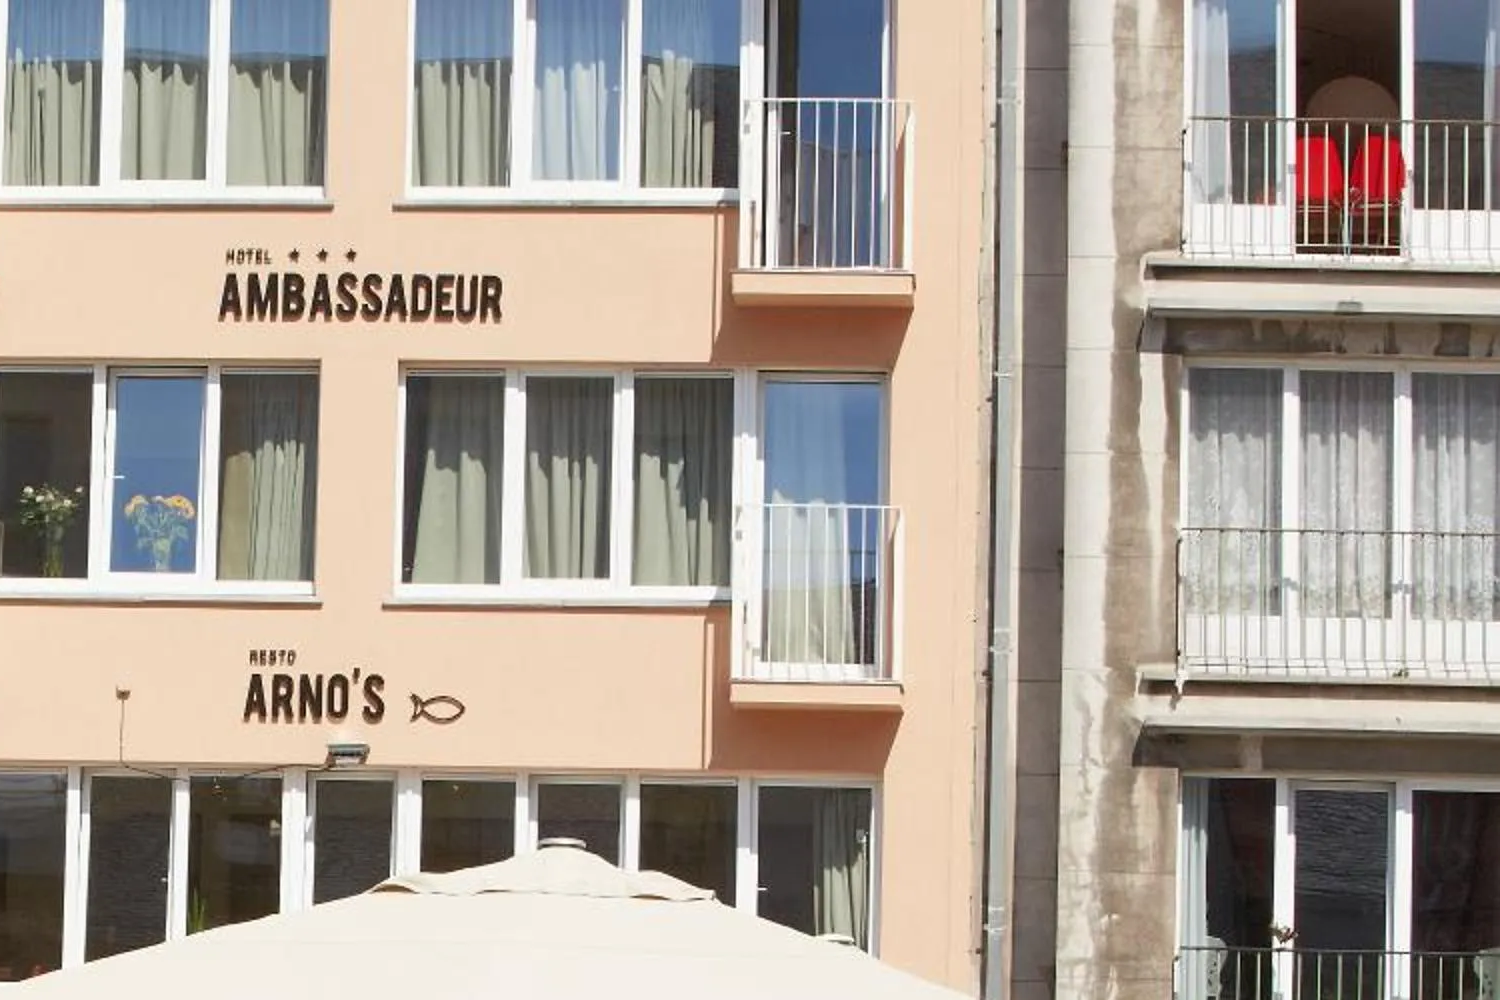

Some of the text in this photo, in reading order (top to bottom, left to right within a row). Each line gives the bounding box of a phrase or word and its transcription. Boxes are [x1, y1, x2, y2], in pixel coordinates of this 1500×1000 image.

[226, 248, 272, 265] HOTEL
[218, 272, 503, 323] AMBASSADEUR
[249, 649, 297, 666] RESTO
[243, 667, 385, 724] ARNO'S
